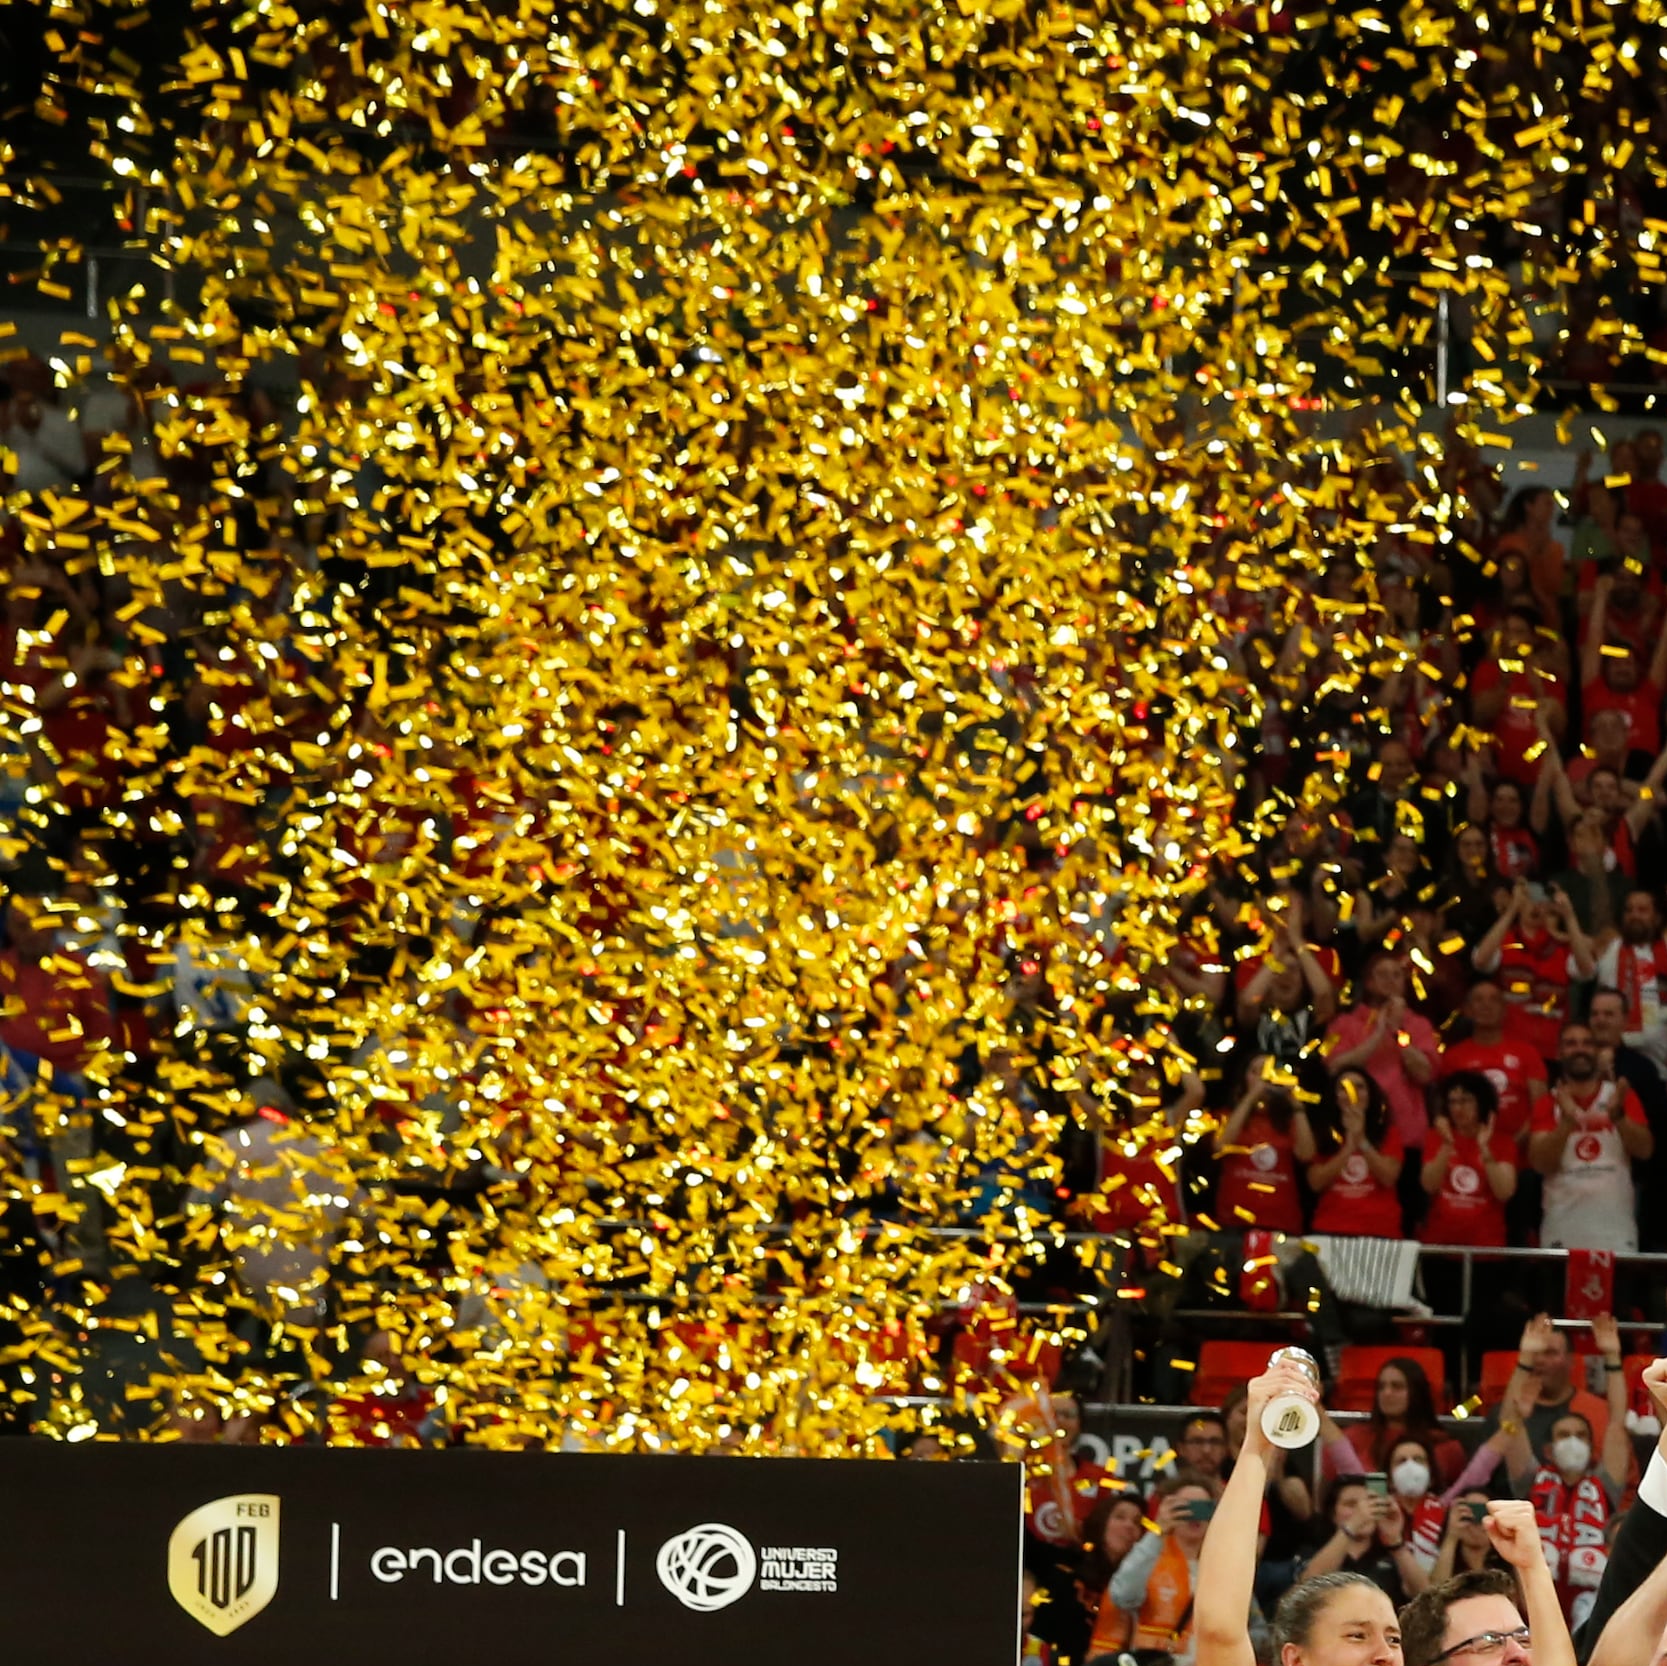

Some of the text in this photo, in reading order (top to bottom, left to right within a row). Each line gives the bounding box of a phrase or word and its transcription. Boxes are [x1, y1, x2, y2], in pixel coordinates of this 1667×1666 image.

[237, 1503, 270, 1518] FEB
[370, 1538, 587, 1586] endesa
[761, 1547, 838, 1561] UNIVERSO
[761, 1561, 837, 1579] MUJER
